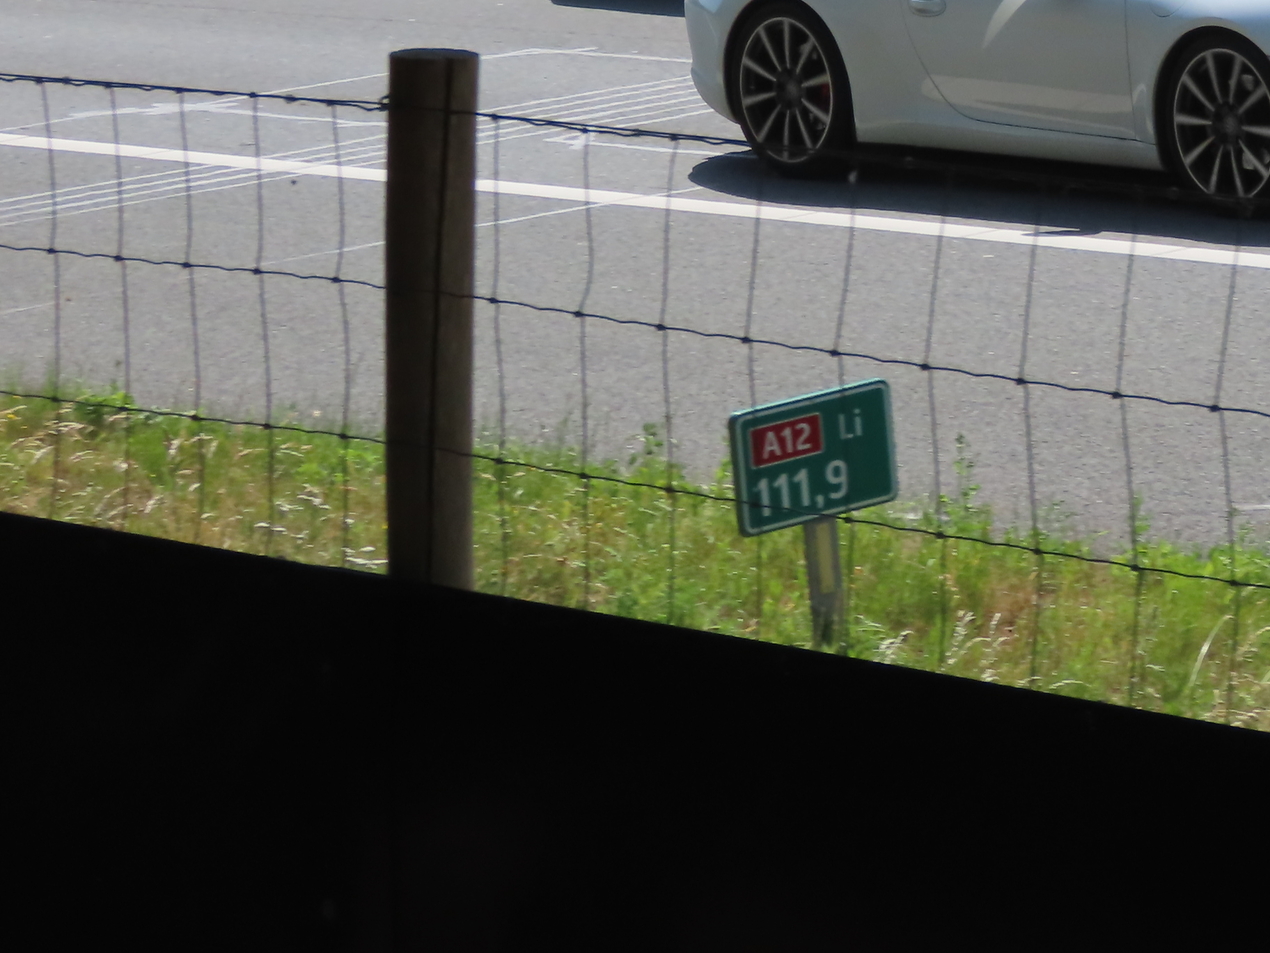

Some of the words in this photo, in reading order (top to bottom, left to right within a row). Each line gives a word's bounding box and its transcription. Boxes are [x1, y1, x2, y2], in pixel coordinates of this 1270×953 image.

[762, 423, 812, 460] A12
[838, 408, 863, 440] Li
[753, 459, 849, 517] 111,9
